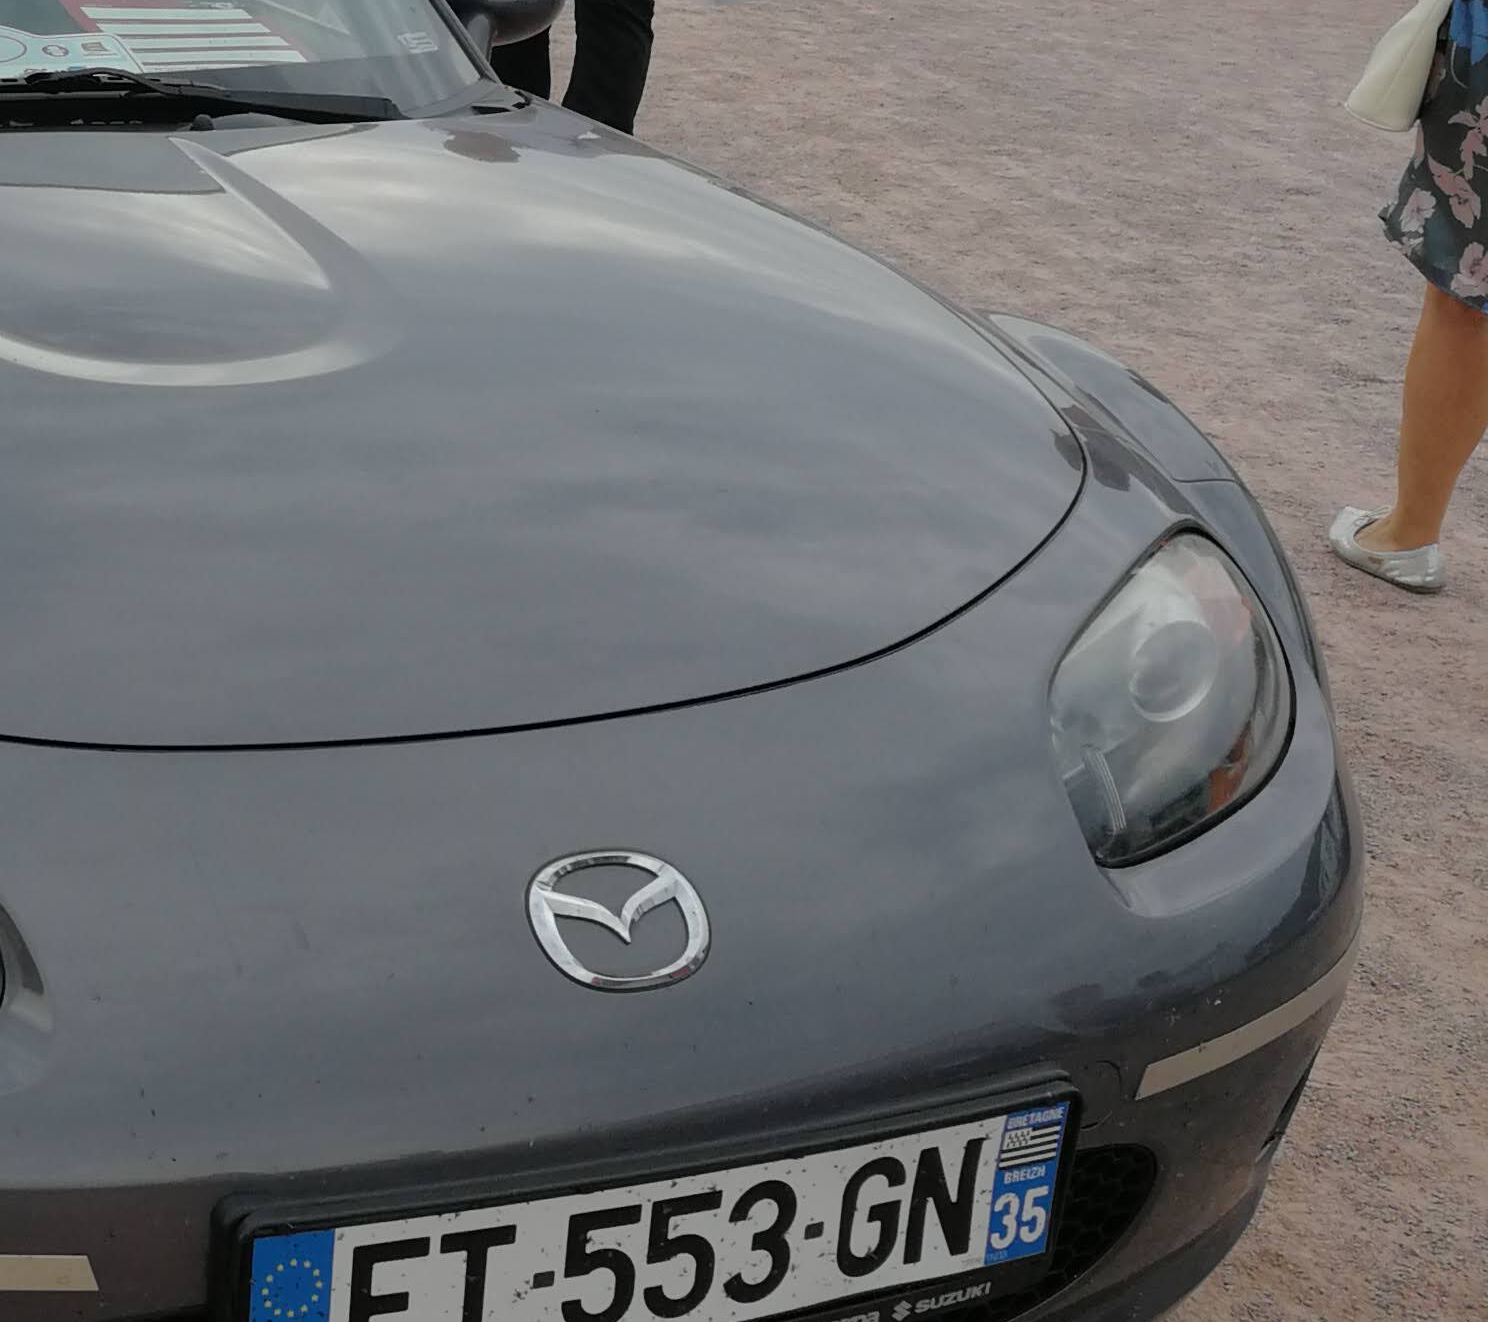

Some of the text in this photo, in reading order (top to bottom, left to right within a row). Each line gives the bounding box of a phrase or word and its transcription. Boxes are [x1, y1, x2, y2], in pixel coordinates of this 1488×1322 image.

[1007, 1106, 1065, 1130] BRETAGNE
[1003, 1164, 1046, 1185] BREIZH
[990, 1185, 1049, 1250] 35
[914, 1281, 993, 1315] SUZUKI
